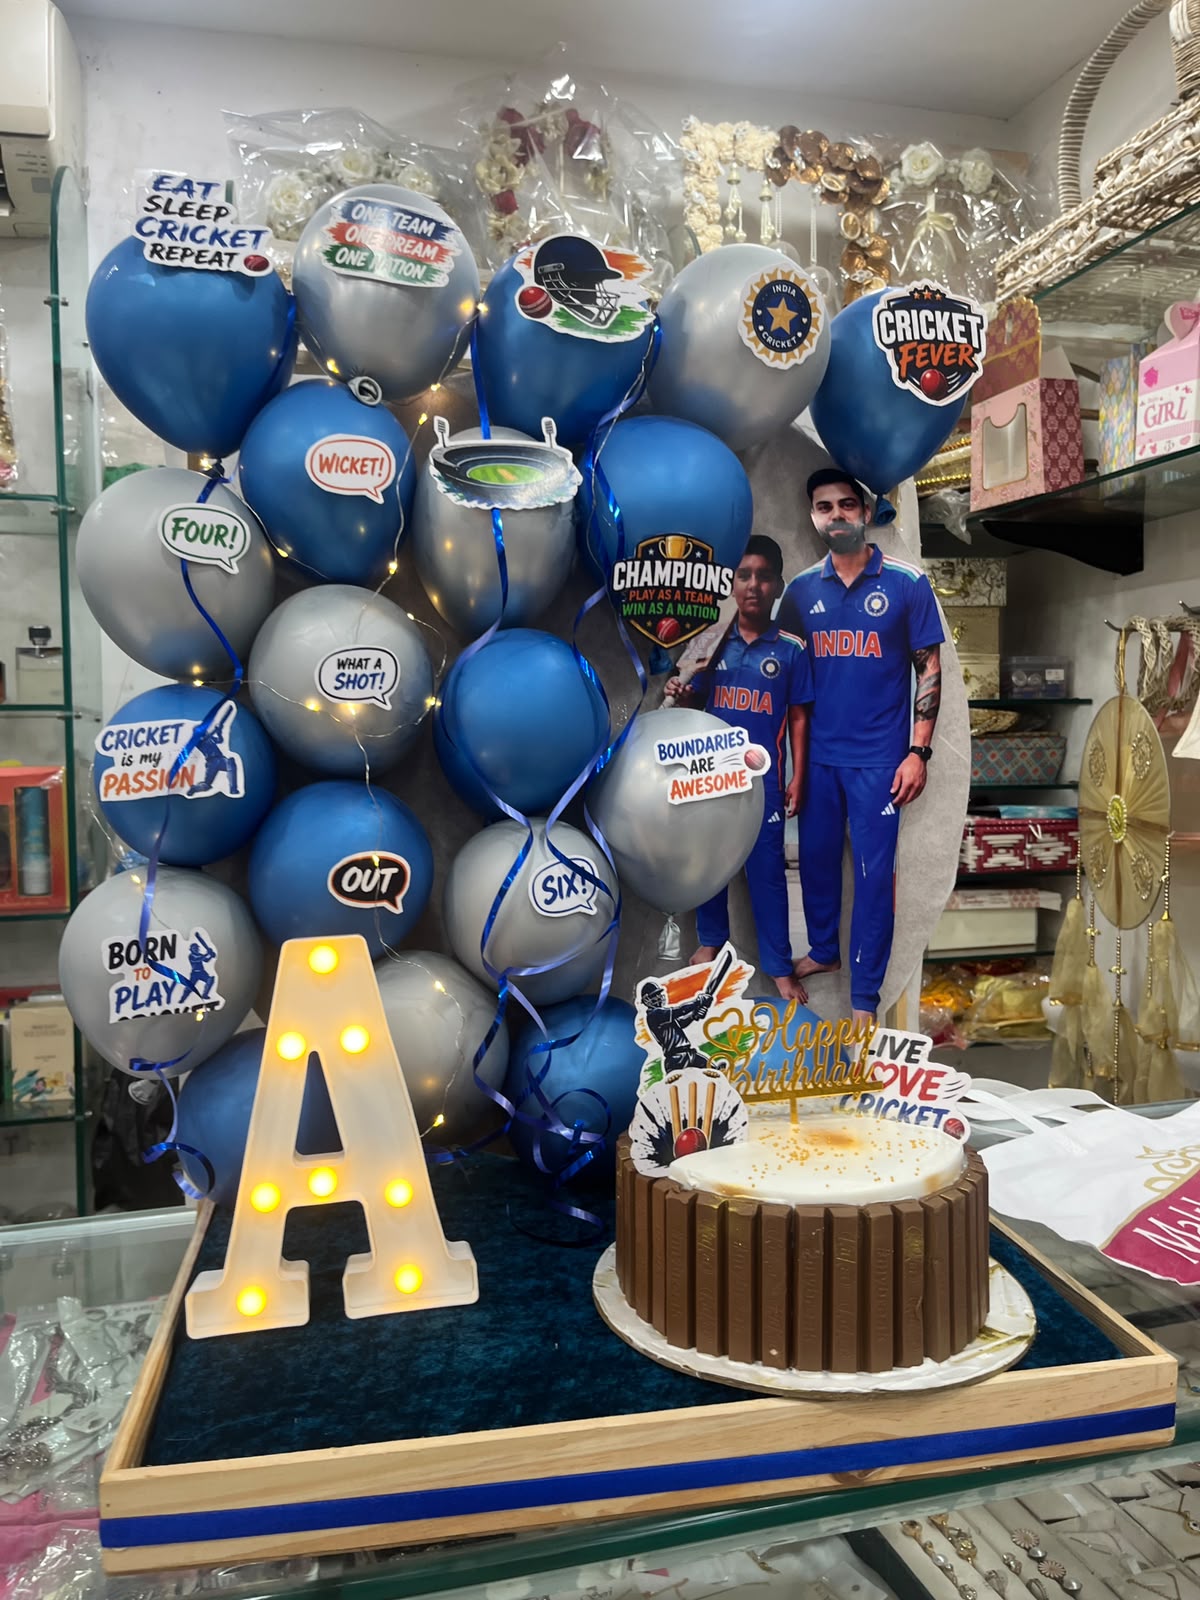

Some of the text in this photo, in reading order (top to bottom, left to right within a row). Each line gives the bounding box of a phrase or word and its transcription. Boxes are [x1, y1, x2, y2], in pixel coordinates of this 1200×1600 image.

[152, 175, 221, 200] EAT
[143, 195, 229, 222] SLEEP
[351, 203, 437, 237] ONE TEAM
[135, 216, 272, 250] CRICKET
[345, 226, 440, 260] ONE DREAM
[149, 243, 239, 268] REPEAT
[335, 248, 427, 280] ONE NATION
[772, 284, 796, 297] INDIA
[762, 332, 797, 348] CRICKET
[878, 308, 984, 349] CRICKET
[899, 342, 975, 383] FEVER
[1144, 396, 1188, 428] GIRL
[319, 453, 385, 477] WICKET!
[171, 517, 239, 550] FOUR!
[613, 560, 734, 597] CHAMPIONS
[622, 602, 718, 621] WIN AS A NATION
[629, 589, 713, 604] PLAY AS A TEAM
[812, 629, 882, 658] INDIA
[337, 657, 382, 670] WHAT A
[334, 671, 386, 691] SHOT!
[714, 685, 773, 715] INDIA
[101, 723, 185, 752] CRICKET
[657, 730, 745, 761] BOUNDARIES
[121, 752, 162, 768] is my
[690, 756, 715, 775] ARE
[670, 769, 748, 800] AWESOME
[341, 866, 399, 894] OUT
[541, 866, 587, 906] SIX!
[108, 933, 177, 970] BORN
[134, 967, 152, 981] TO
[115, 980, 178, 1014] PLAY
[749, 997, 881, 1066] Happy
[707, 1050, 876, 1096] Birthday
